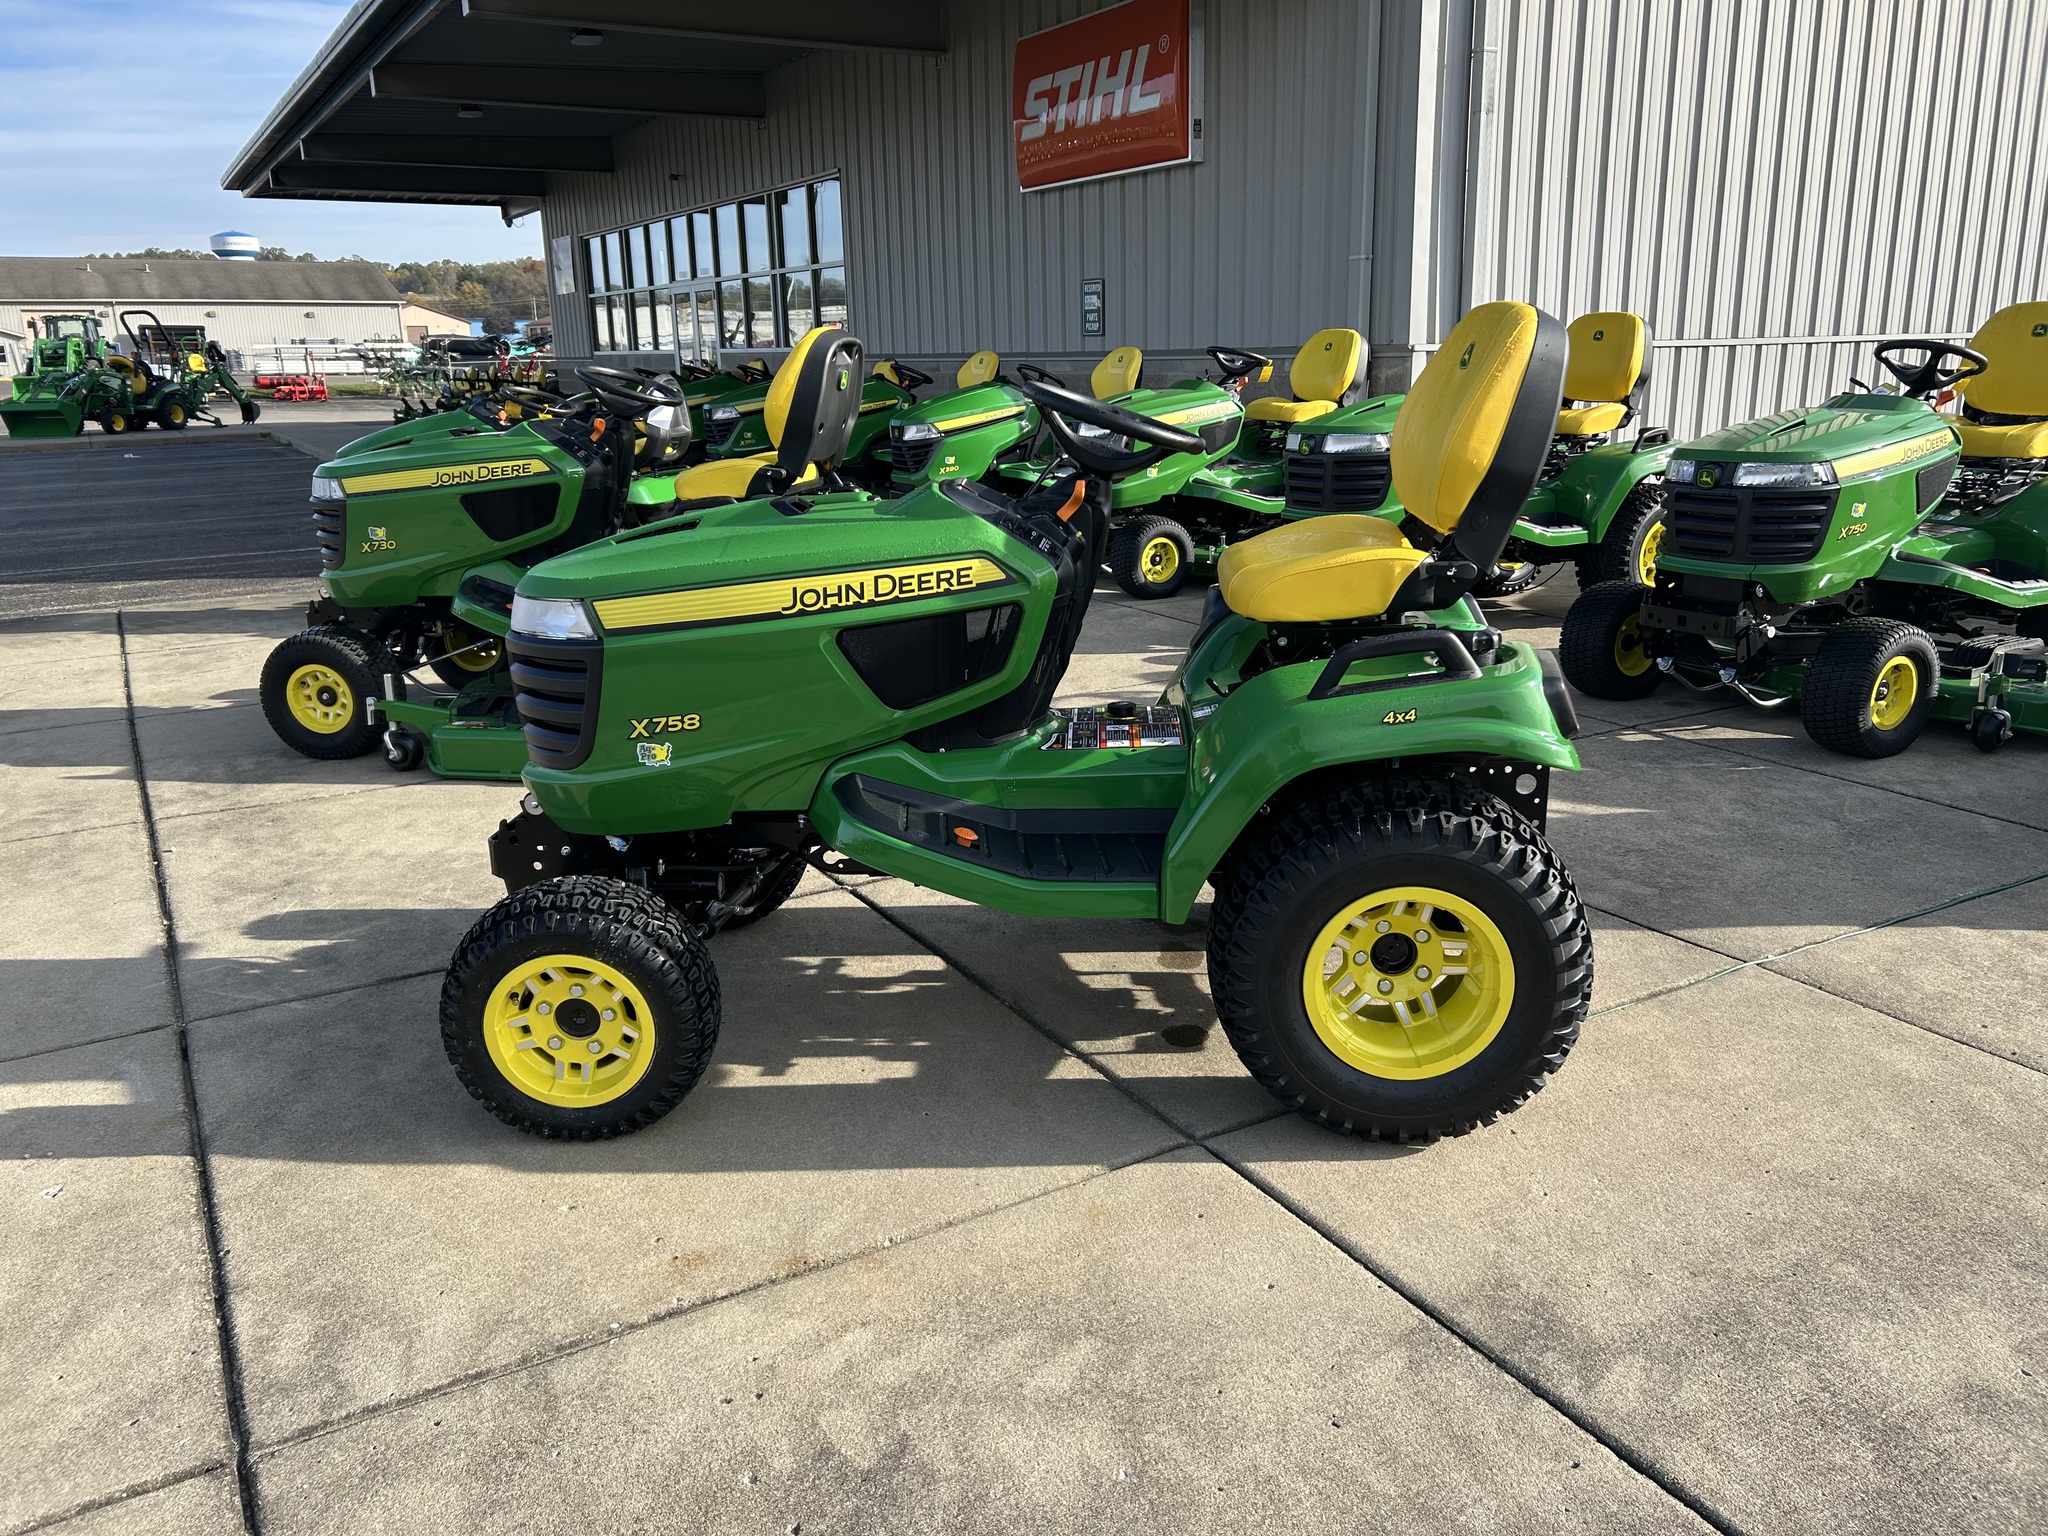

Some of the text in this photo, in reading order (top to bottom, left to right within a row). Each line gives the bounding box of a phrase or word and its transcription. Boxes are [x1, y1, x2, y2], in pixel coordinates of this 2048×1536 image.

[1184, 405, 1229, 421] JOHN DEERE
[1901, 434, 1948, 461] JOHN DEERE
[431, 462, 532, 486] JOHN DEERE
[938, 464, 960, 475] X390
[1837, 522, 1867, 540] X750
[361, 540, 396, 553] X730
[781, 566, 974, 613] JOHN DEERE
[1382, 708, 1417, 724] 4x4
[628, 713, 701, 739] X758
